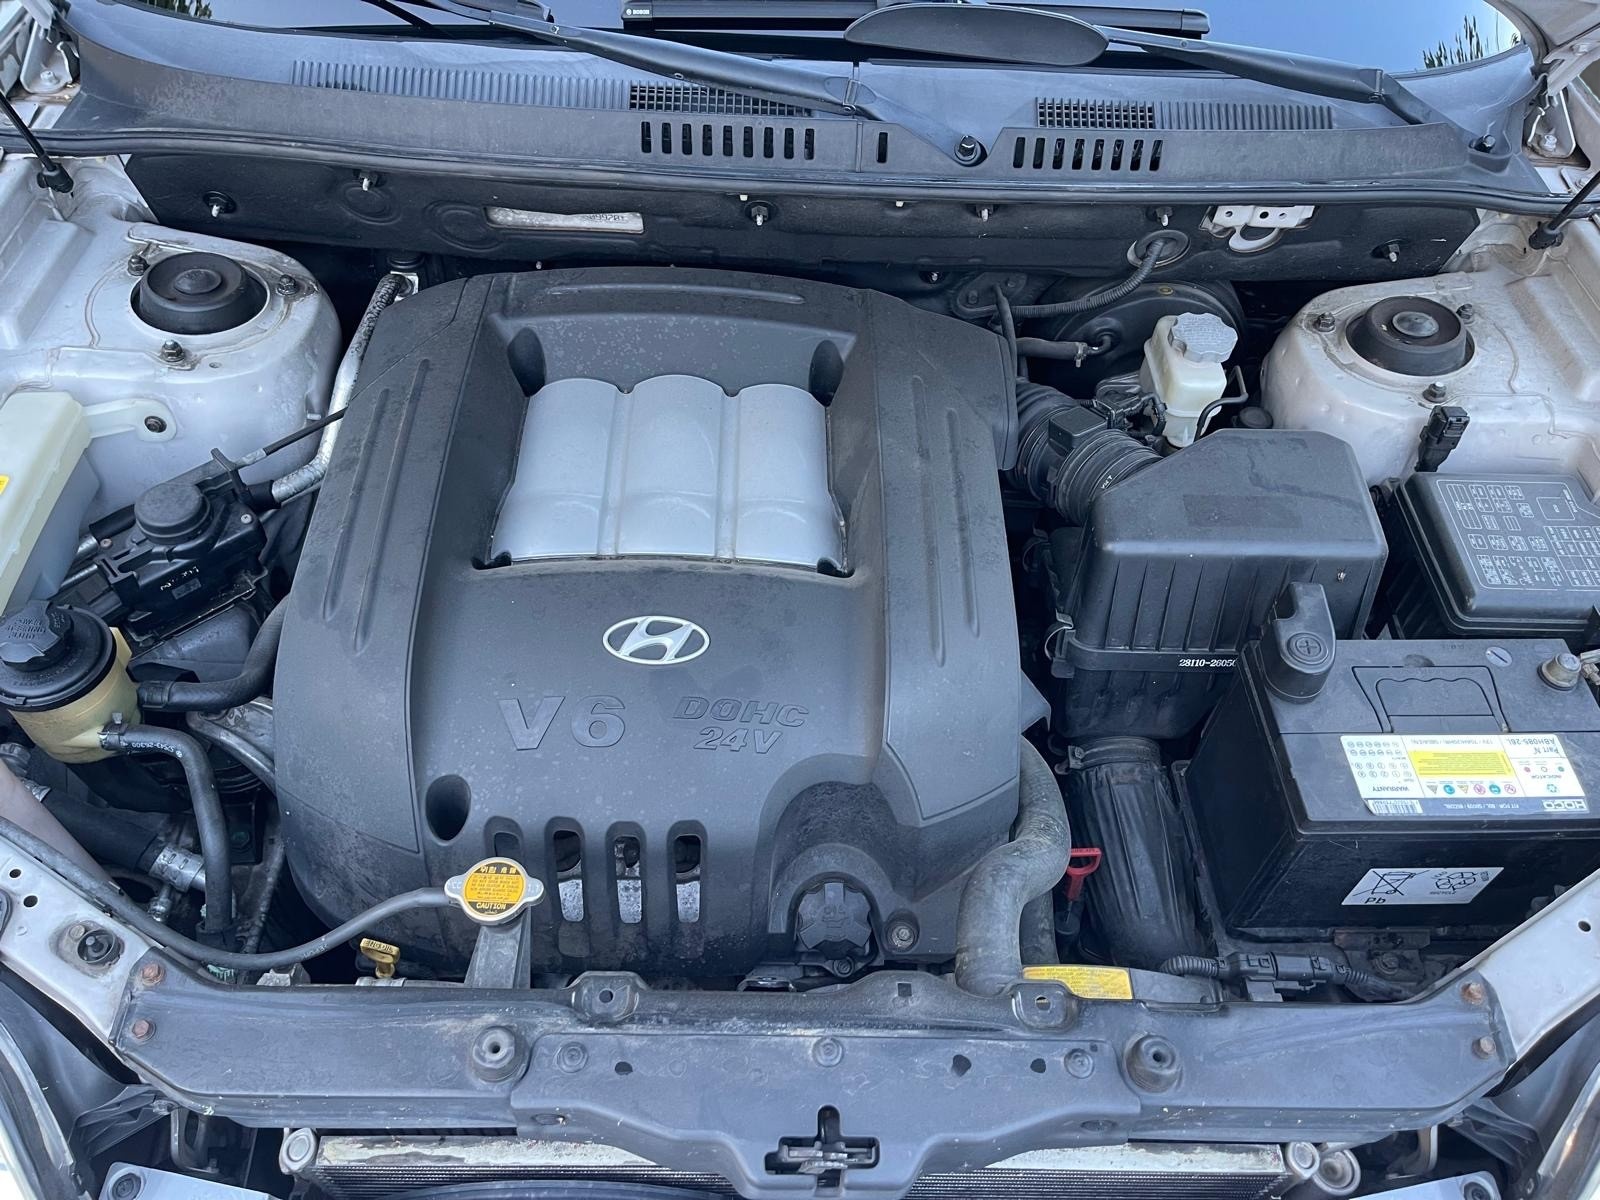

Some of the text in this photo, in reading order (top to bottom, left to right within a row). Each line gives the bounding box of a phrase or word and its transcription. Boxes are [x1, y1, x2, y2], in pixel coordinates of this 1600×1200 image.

[672, 696, 809, 728] DOHC
[693, 726, 783, 754] 24V
[476, 902, 506, 910] CAUTION
[1364, 896, 1387, 904] Pb
